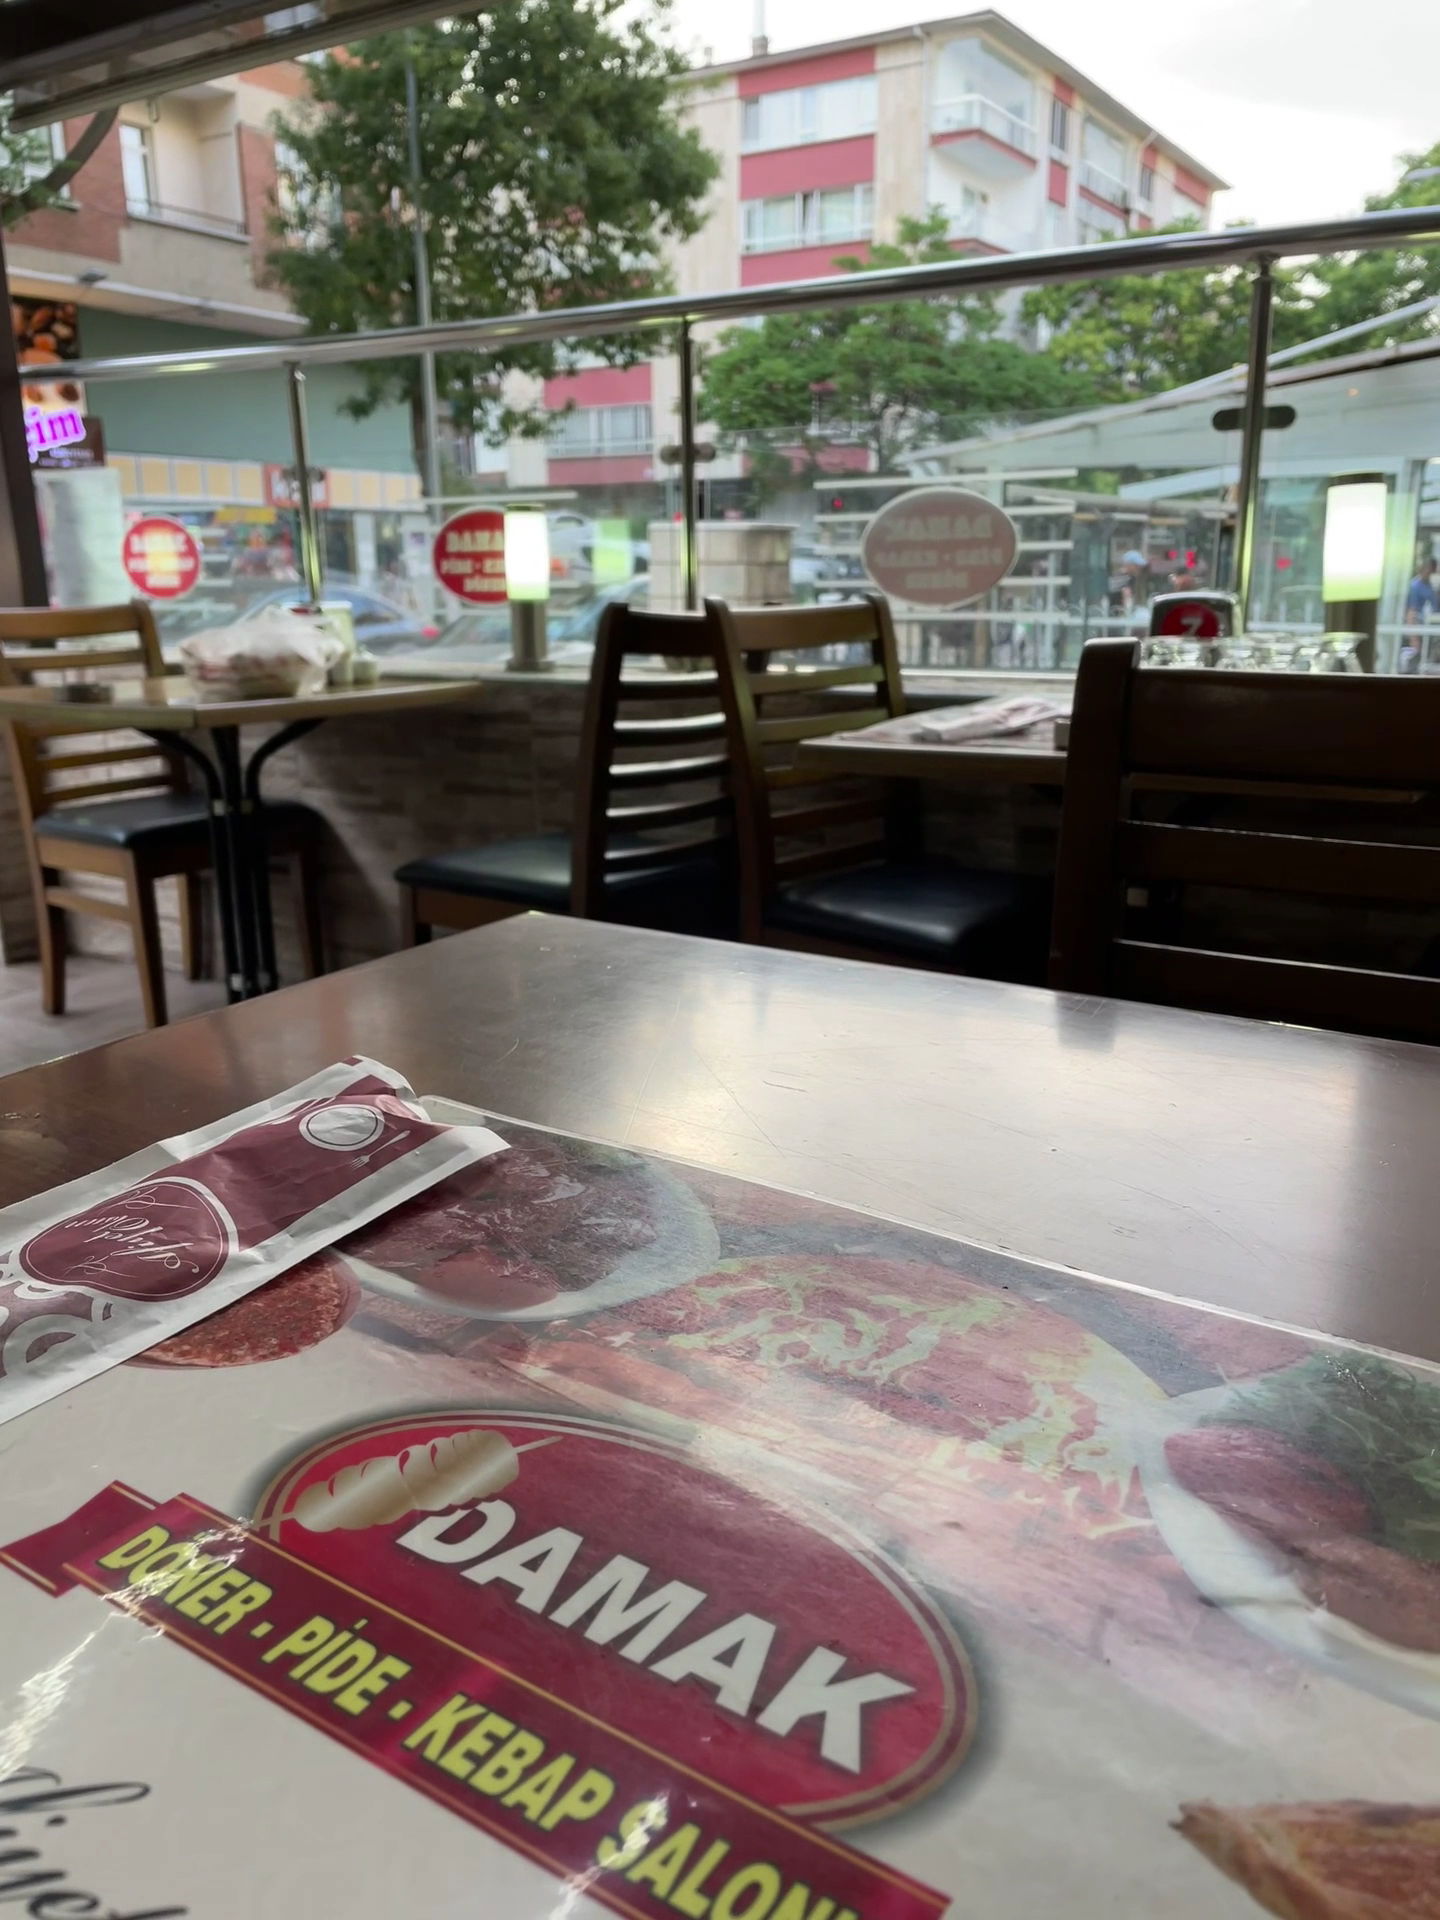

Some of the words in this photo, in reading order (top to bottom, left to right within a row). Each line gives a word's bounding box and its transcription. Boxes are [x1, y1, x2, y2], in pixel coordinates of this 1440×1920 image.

[261, 1617, 412, 1717] PİDE
[403, 1692, 615, 1831] KEBAP
[596, 1798, 860, 1920] SALO
[395, 1499, 917, 1774] DAMAK
